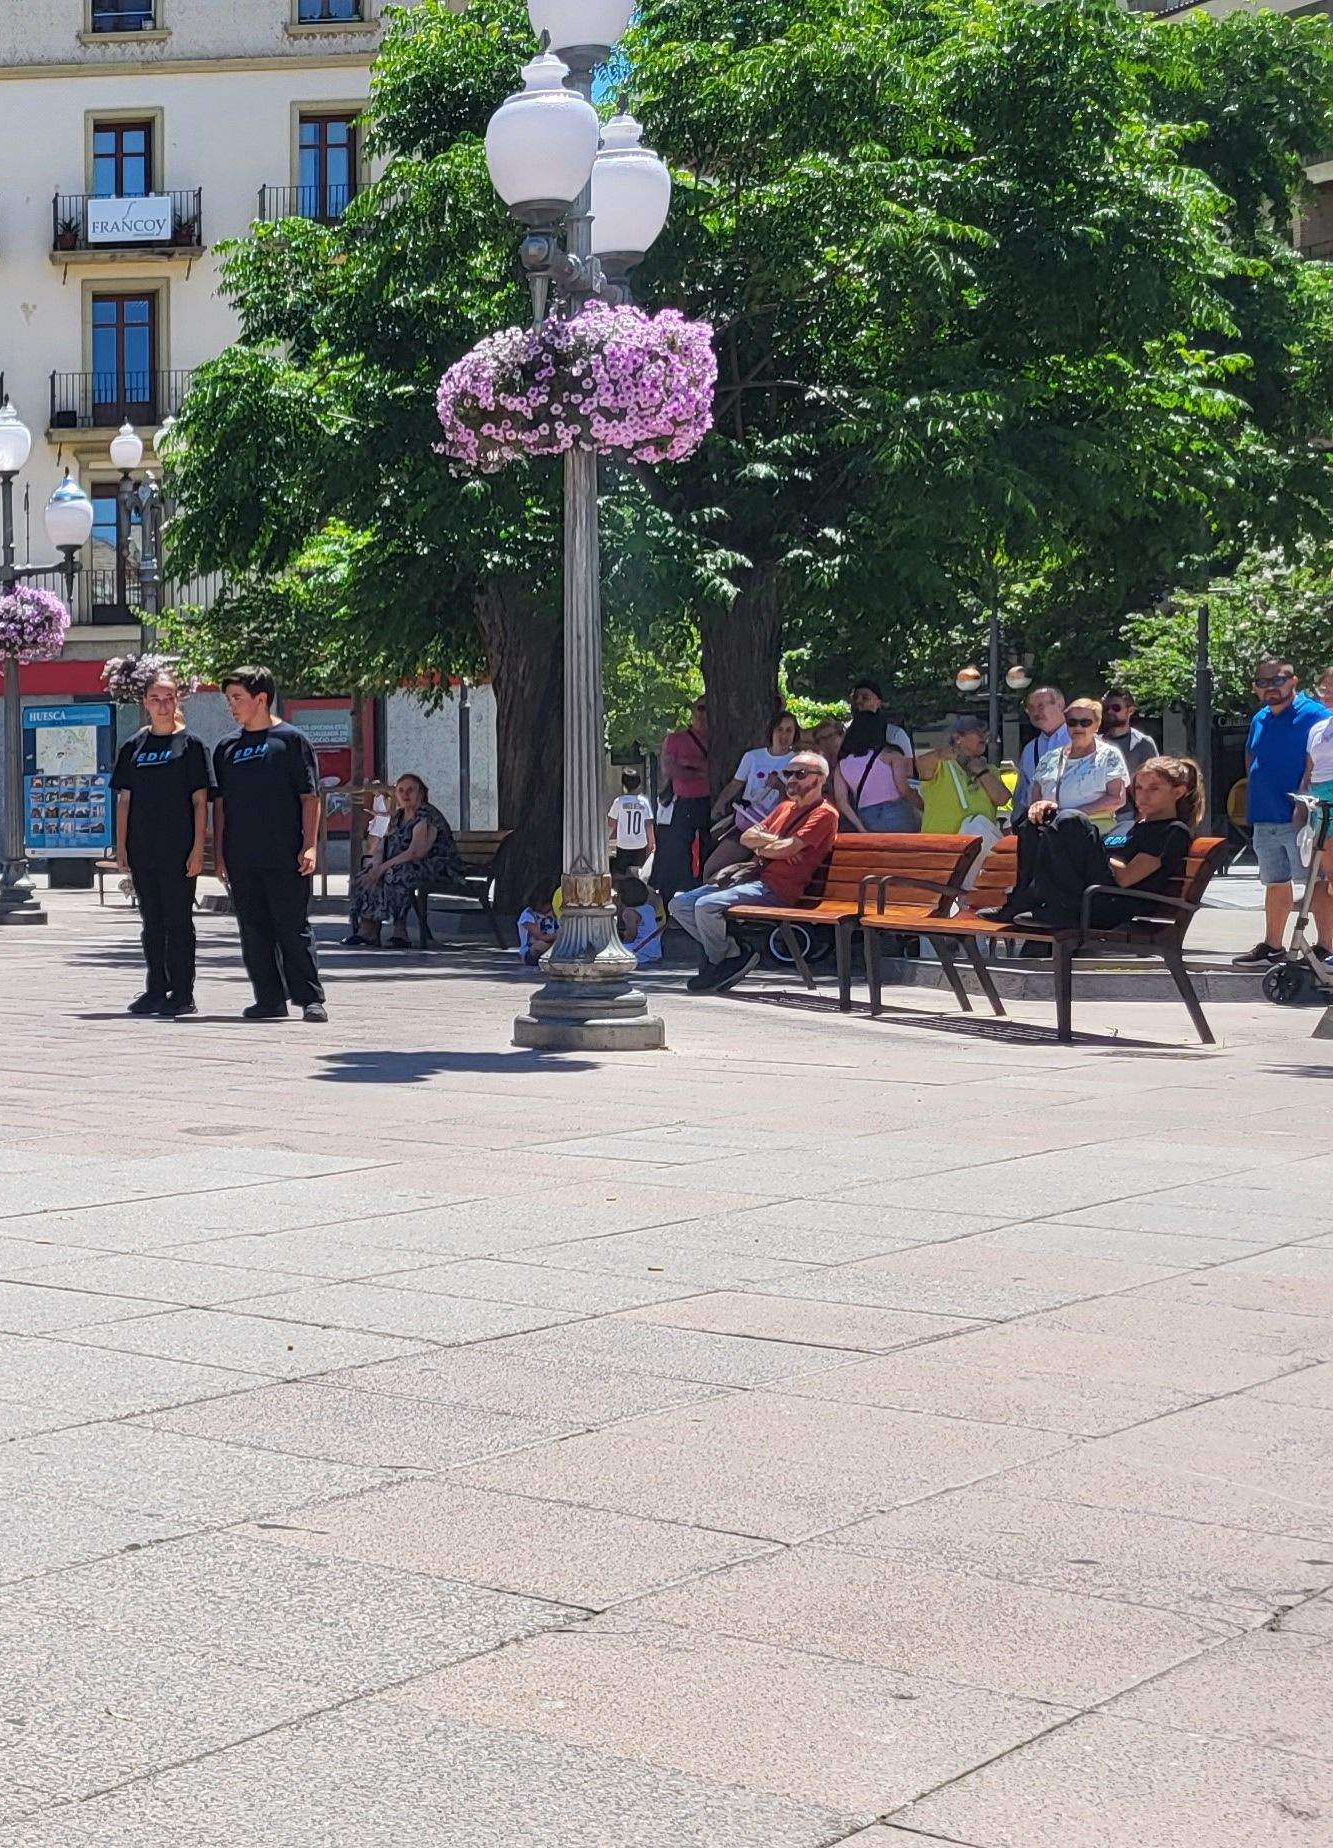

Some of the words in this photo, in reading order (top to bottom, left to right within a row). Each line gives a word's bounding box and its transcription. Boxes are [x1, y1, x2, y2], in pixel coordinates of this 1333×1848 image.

[91, 219, 167, 237] FRANCOY
[29, 710, 68, 722] HUESCA
[626, 811, 642, 835] 10
